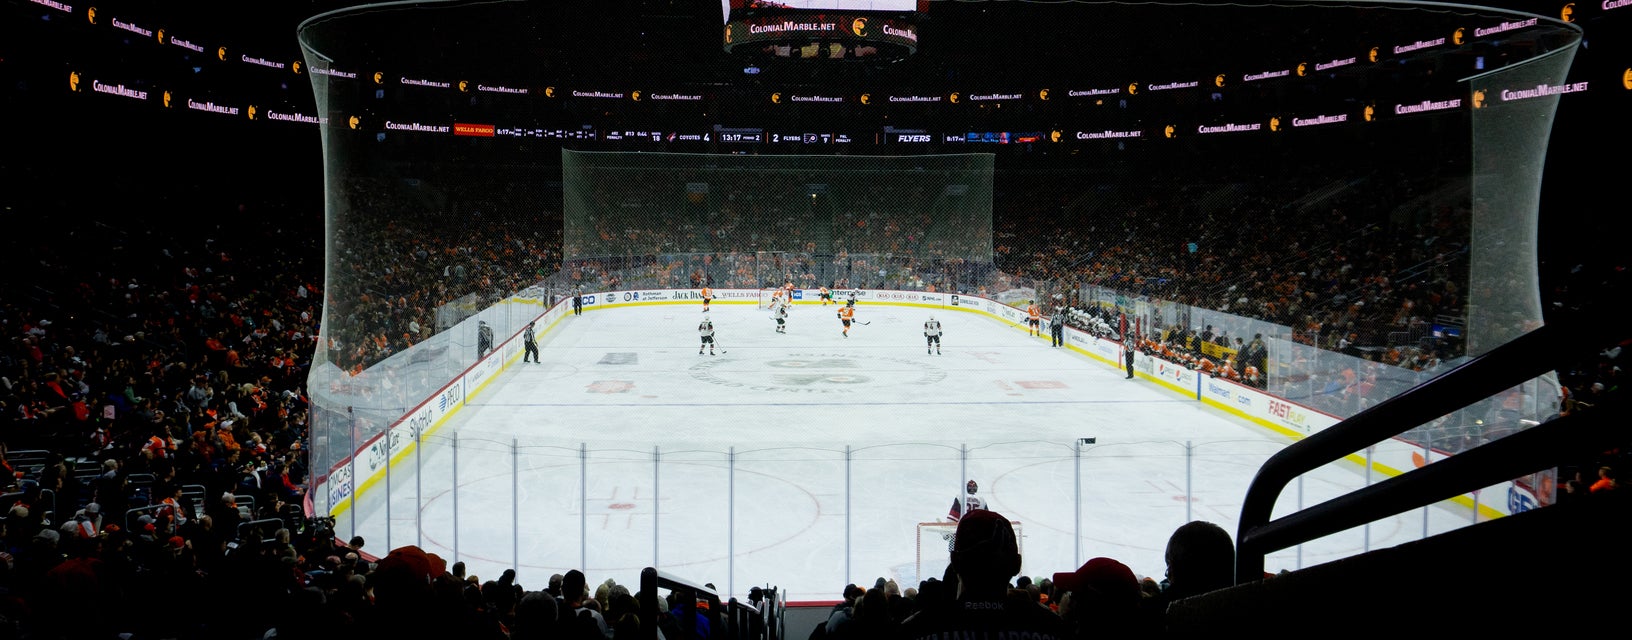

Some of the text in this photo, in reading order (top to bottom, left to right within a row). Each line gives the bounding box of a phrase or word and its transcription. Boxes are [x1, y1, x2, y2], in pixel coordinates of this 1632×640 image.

[703, 133, 710, 142] 4
[722, 133, 742, 142] 13:17
[755, 134, 761, 142] 2
[772, 133, 779, 143] 2
[897, 134, 932, 143] FLYERS
[672, 291, 689, 300] JACK
[447, 383, 460, 408] PECO
[964, 601, 1004, 610] Reebok
